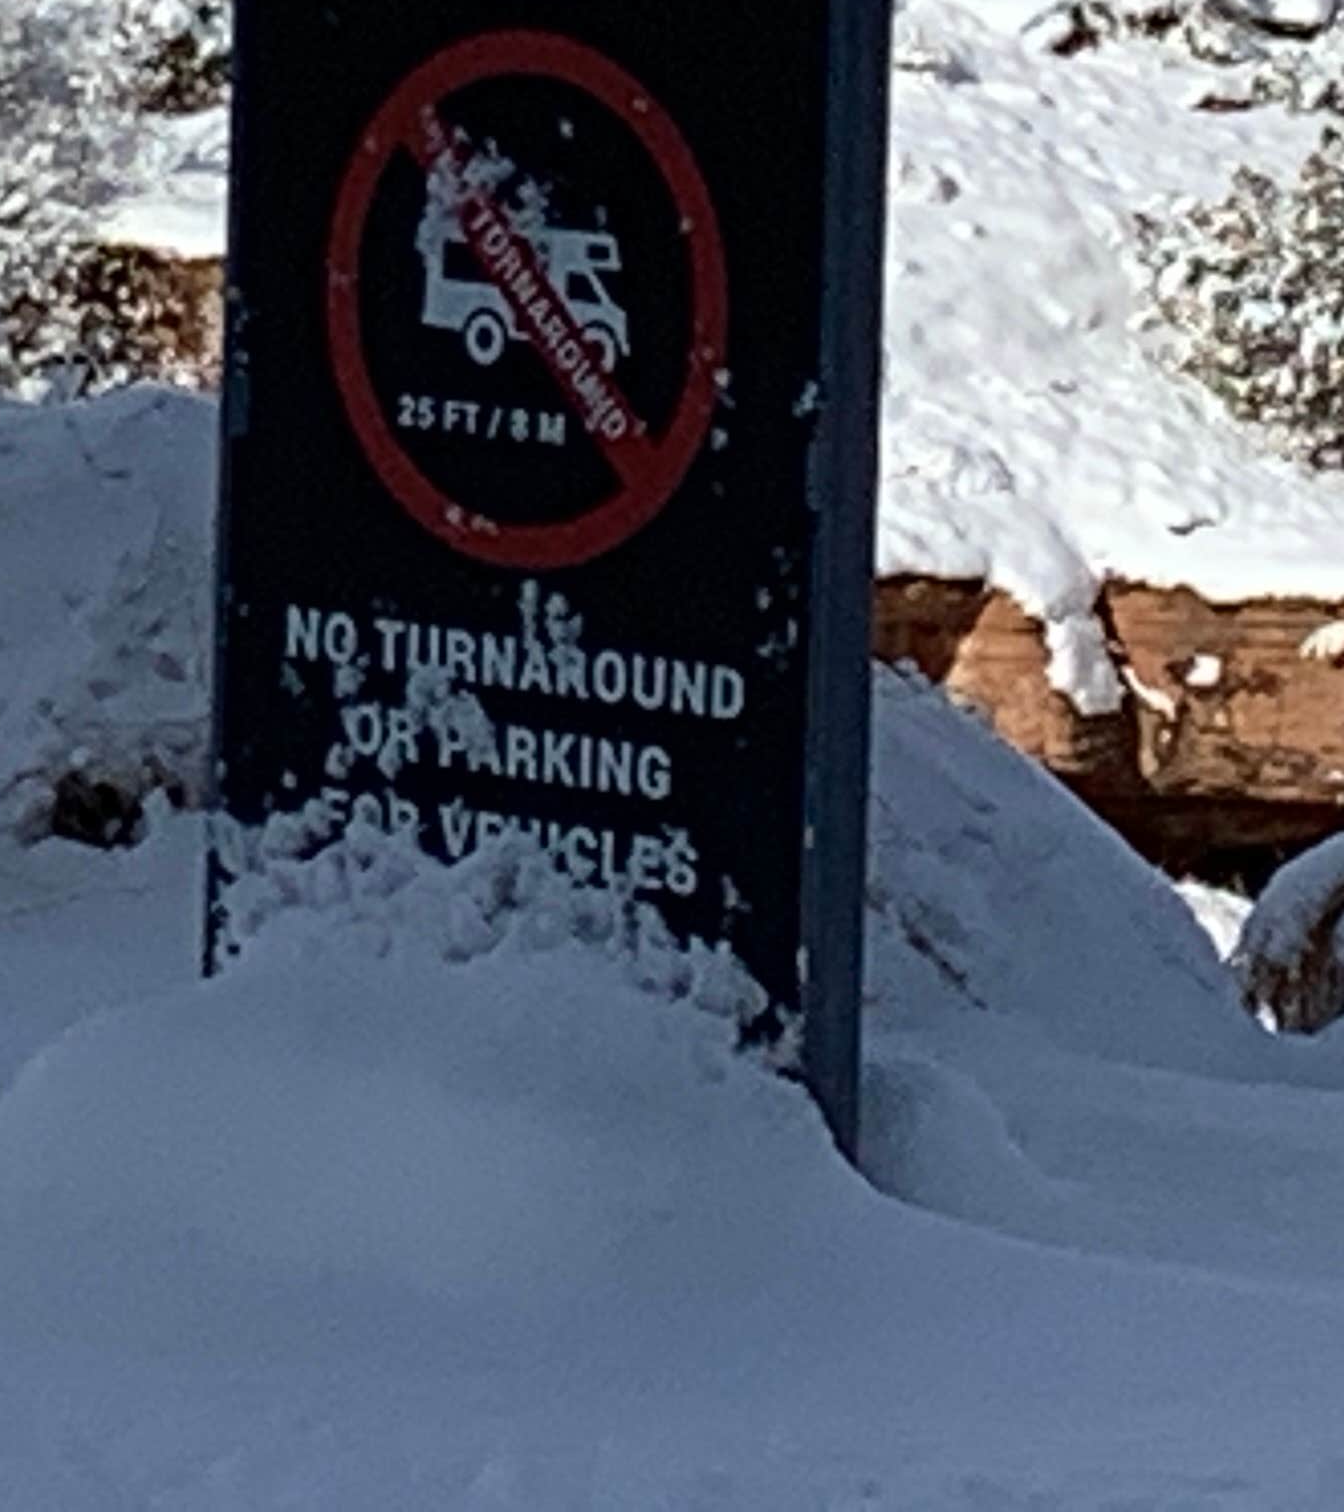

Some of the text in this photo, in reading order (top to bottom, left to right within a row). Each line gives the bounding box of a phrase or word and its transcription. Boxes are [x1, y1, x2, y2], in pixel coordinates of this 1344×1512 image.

[467, 206, 629, 442] TURNAROUND
[397, 394, 567, 447] 25 FT / 8 M
[284, 603, 747, 720] NO TURNAROUND
[344, 704, 420, 764] OR
